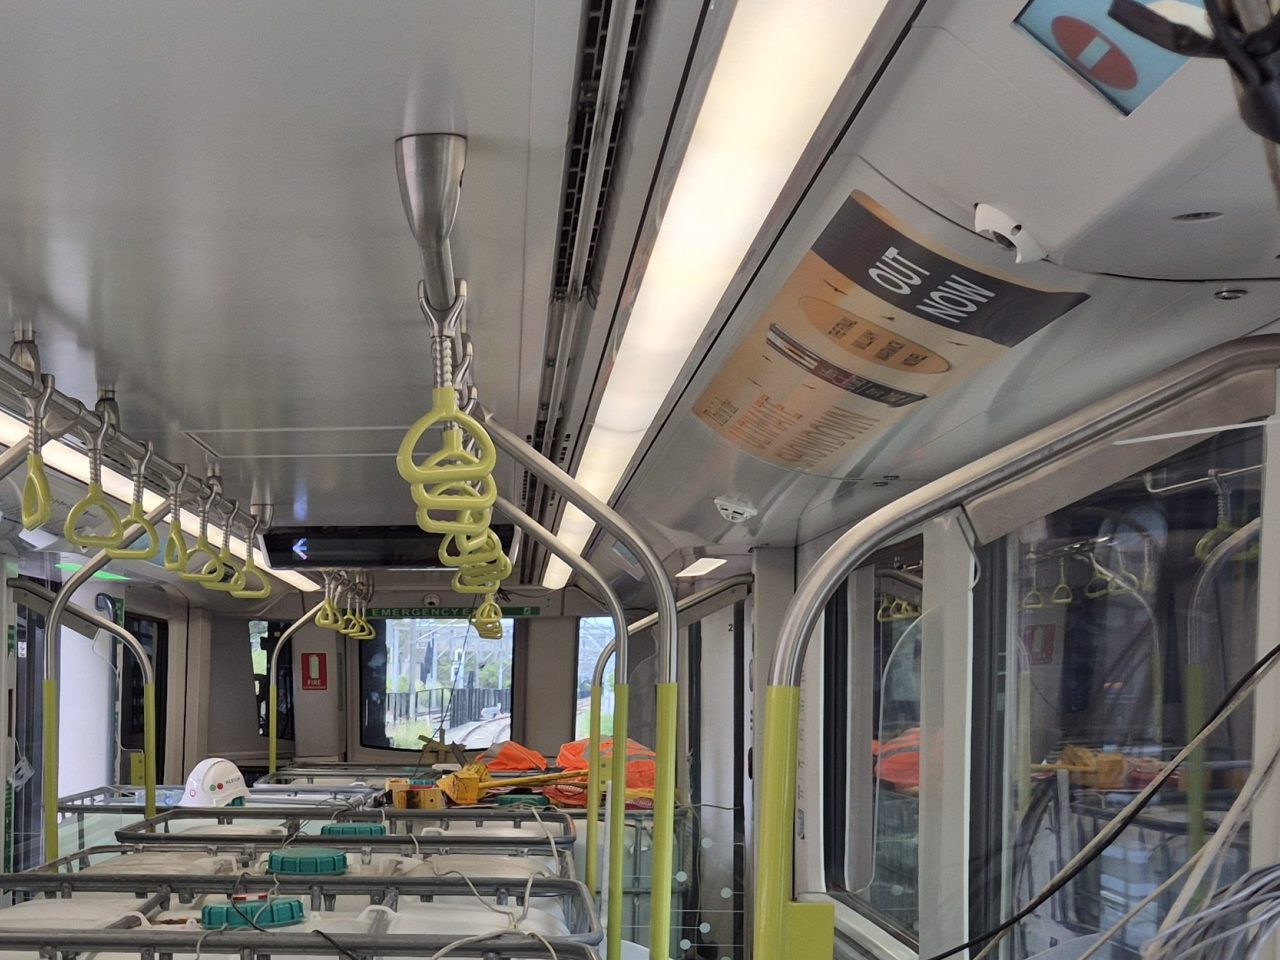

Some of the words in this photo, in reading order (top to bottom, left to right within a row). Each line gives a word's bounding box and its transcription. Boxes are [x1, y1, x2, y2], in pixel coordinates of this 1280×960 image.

[868, 246, 932, 294] OUT
[916, 274, 998, 323] NOW
[372, 608, 460, 616] EMERGENCY
[728, 624, 734, 632] 2
